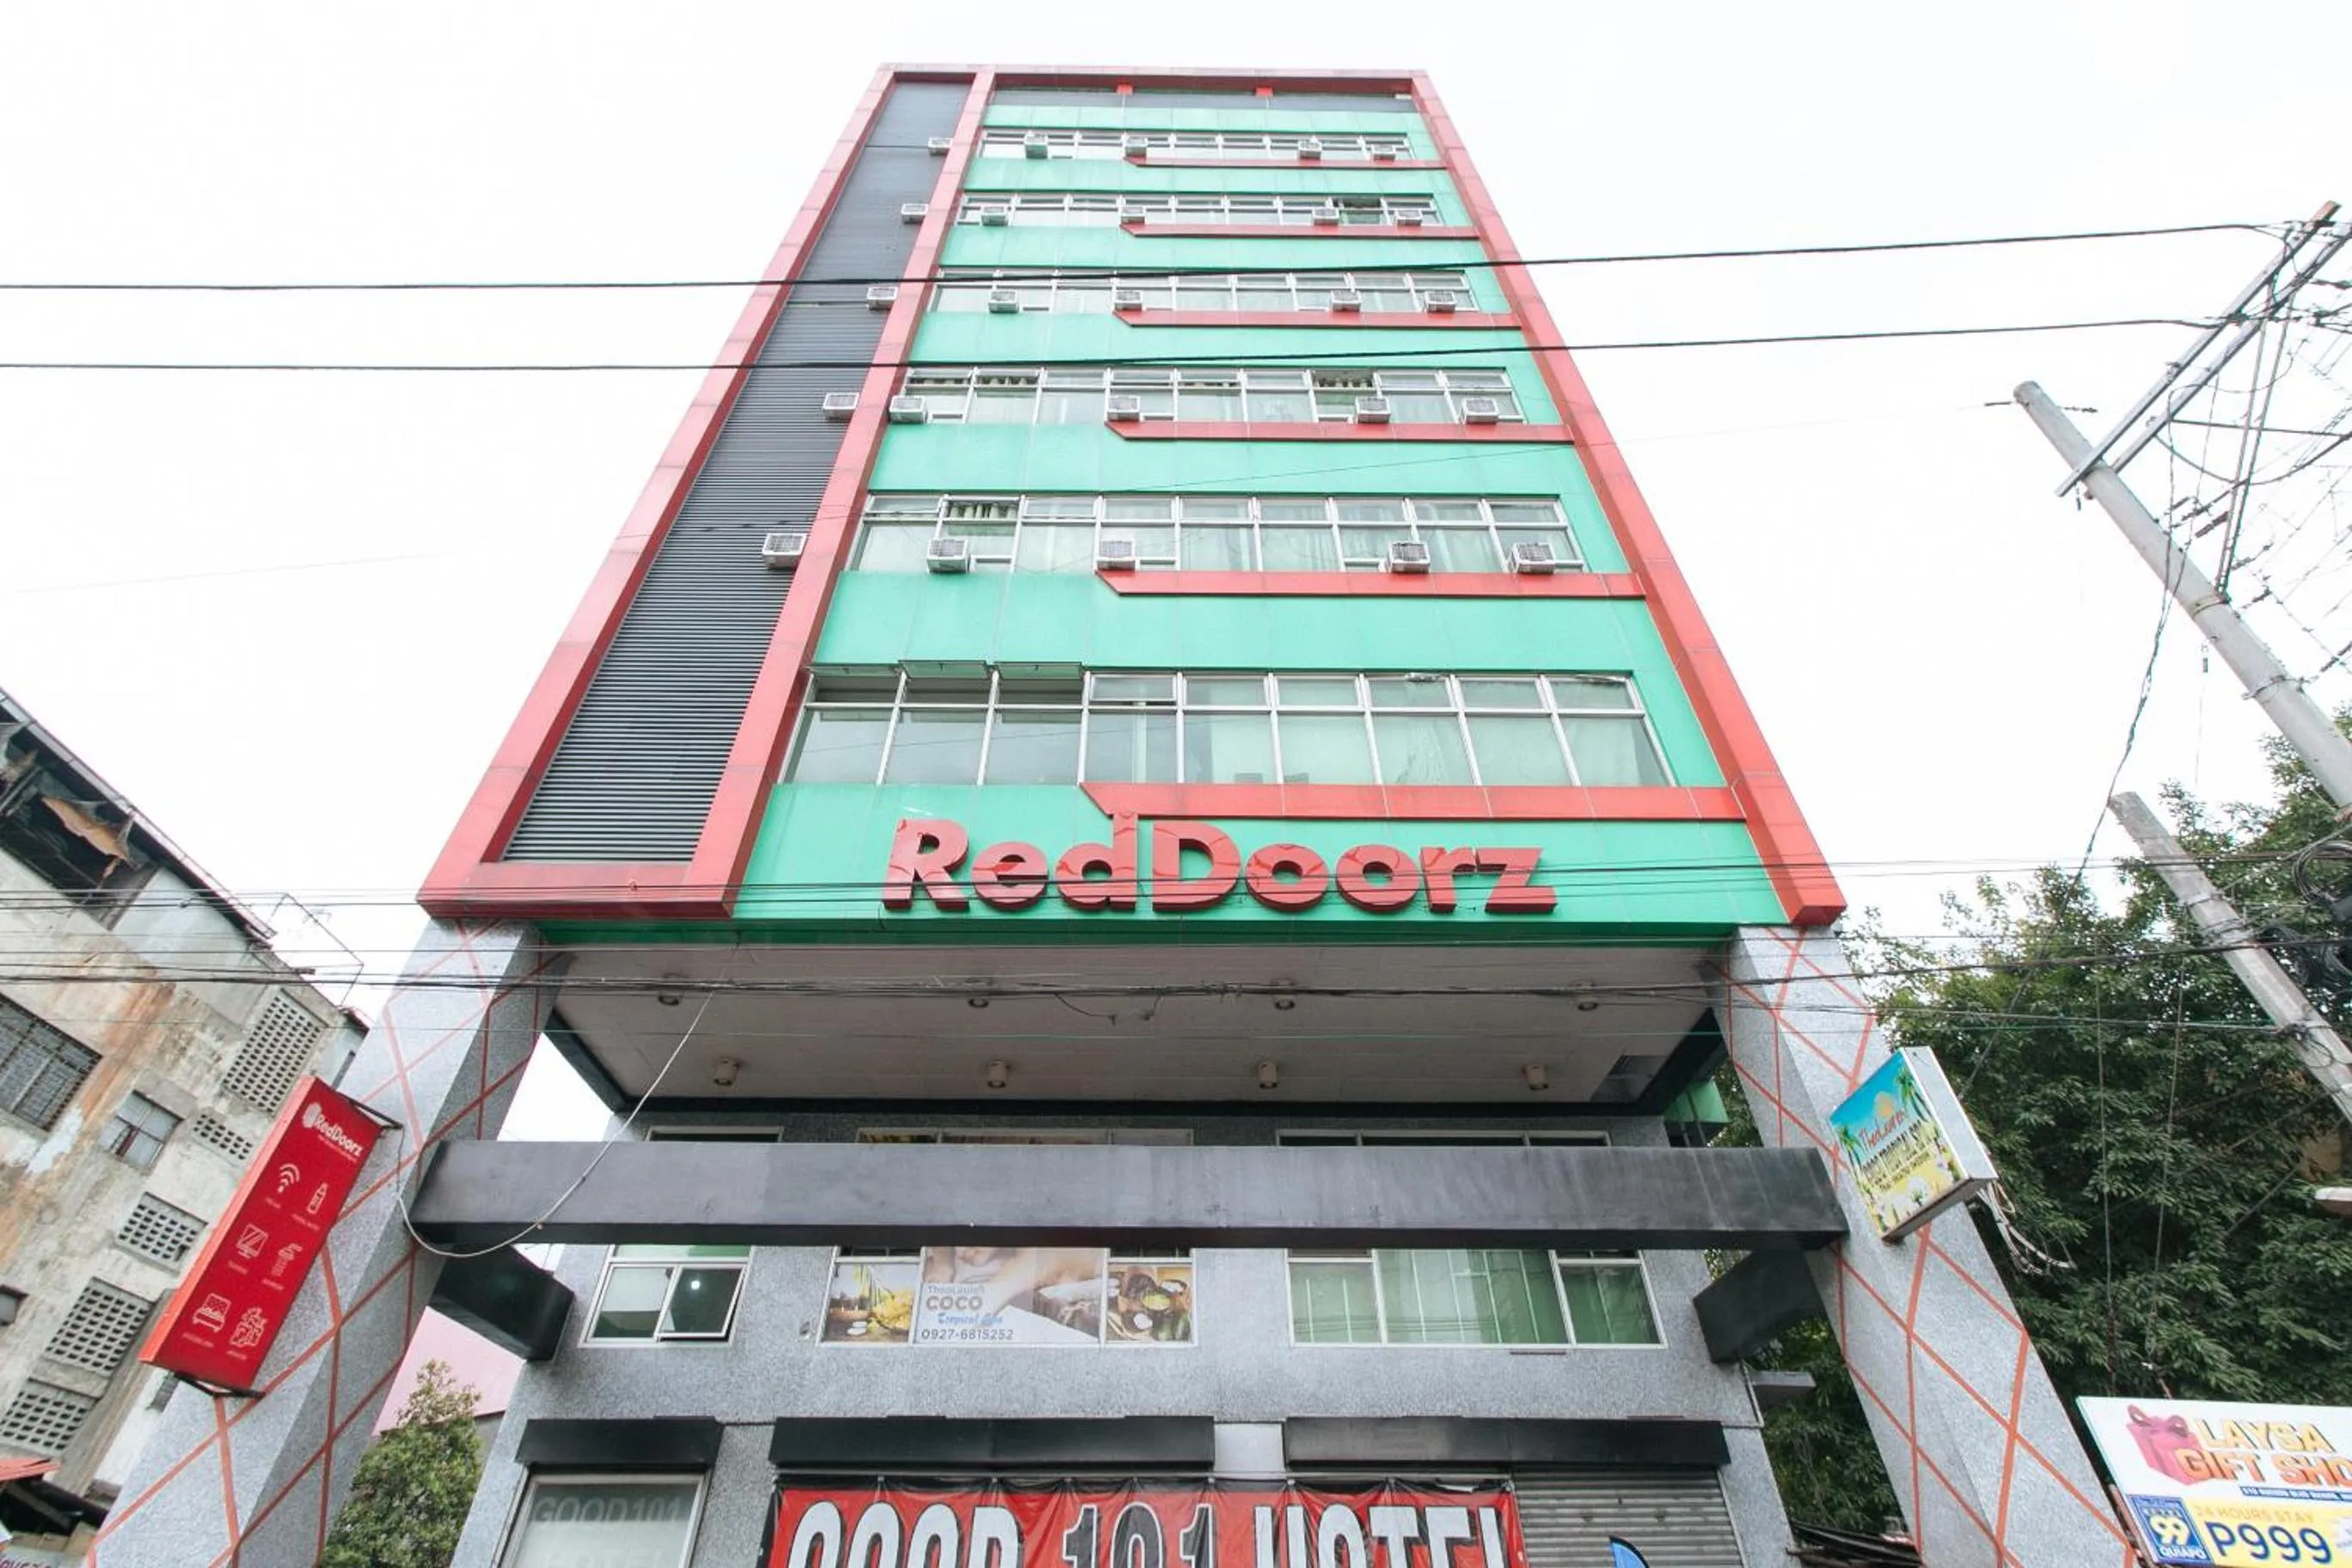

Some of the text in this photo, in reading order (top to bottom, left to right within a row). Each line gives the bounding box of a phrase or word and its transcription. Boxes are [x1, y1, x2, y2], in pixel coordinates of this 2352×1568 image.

[883, 812, 1558, 912] RedDoorz
[926, 1295, 983, 1311] COCO
[2194, 1418, 2337, 1453] LAYSA
[2173, 1448, 2266, 1482] GIFT
[2204, 1521, 2332, 1564] P999
